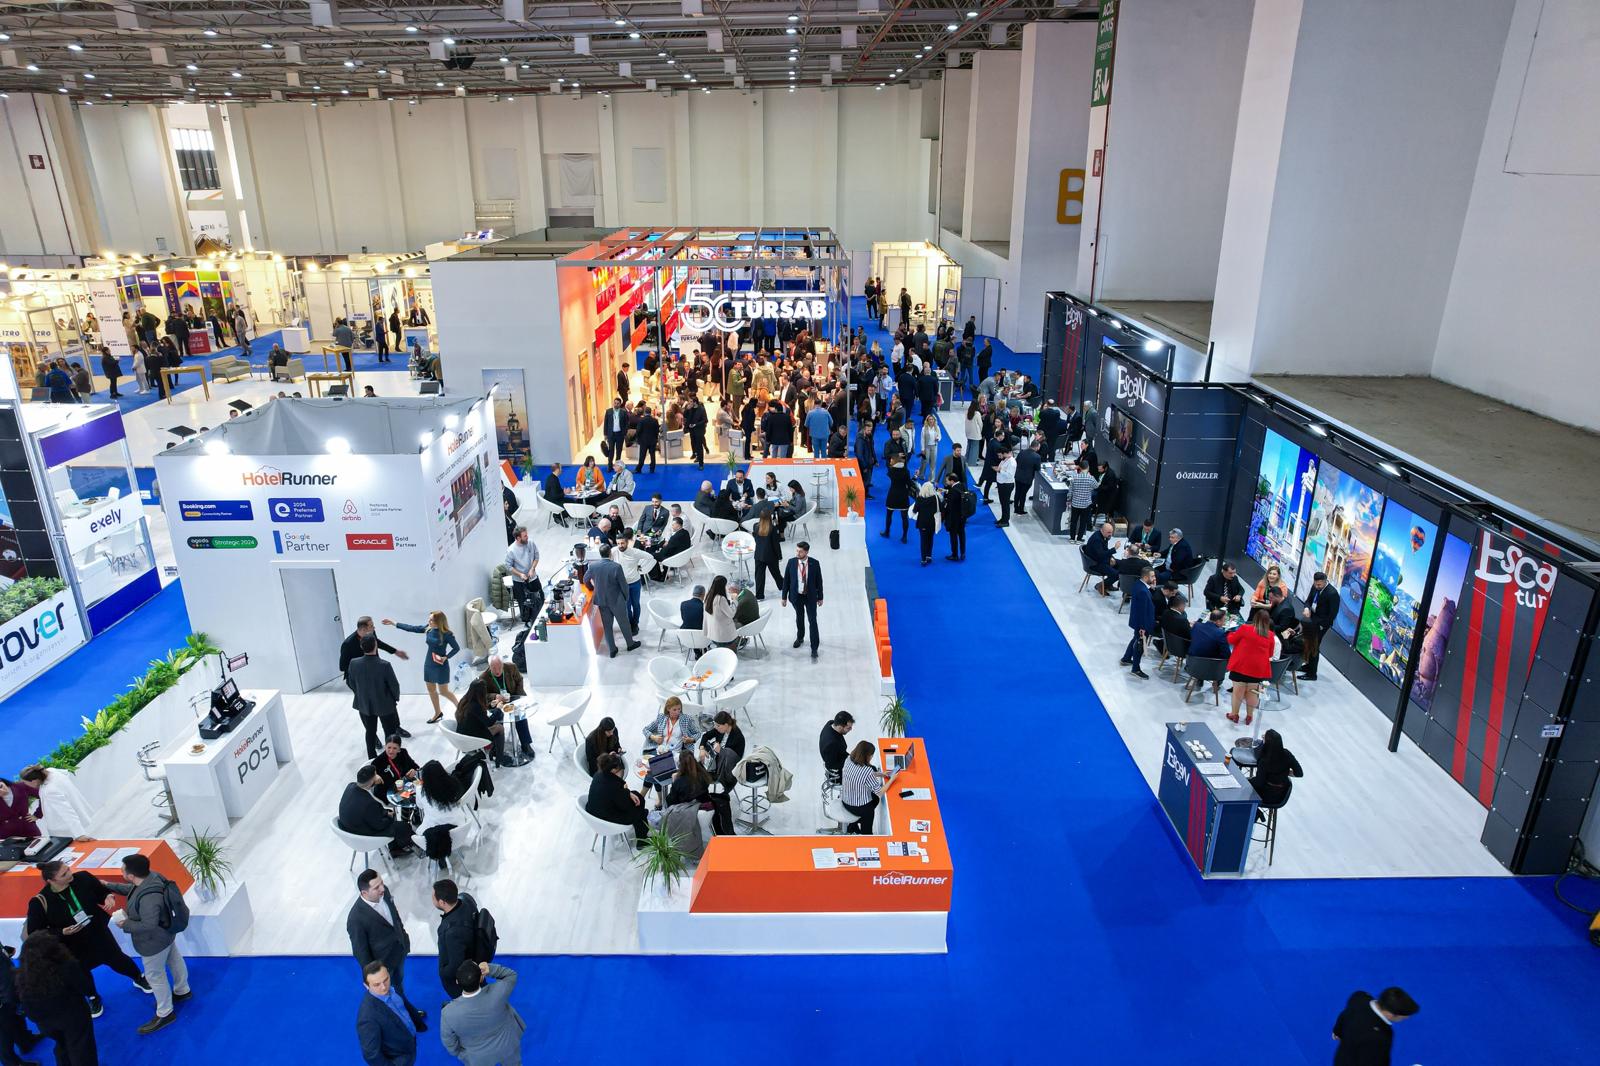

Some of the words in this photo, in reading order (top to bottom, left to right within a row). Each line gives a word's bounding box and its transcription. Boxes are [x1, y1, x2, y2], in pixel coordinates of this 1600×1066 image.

[1057, 169, 1086, 224] B
[242, 471, 337, 486] HotelRunner
[90, 508, 121, 533] exely
[285, 533, 310, 541] Google
[286, 541, 330, 551] Partner
[1514, 588, 1547, 609] tur
[233, 724, 264, 759] HotelRunner
[237, 738, 270, 784] POS
[872, 875, 948, 886] HotelRunner
